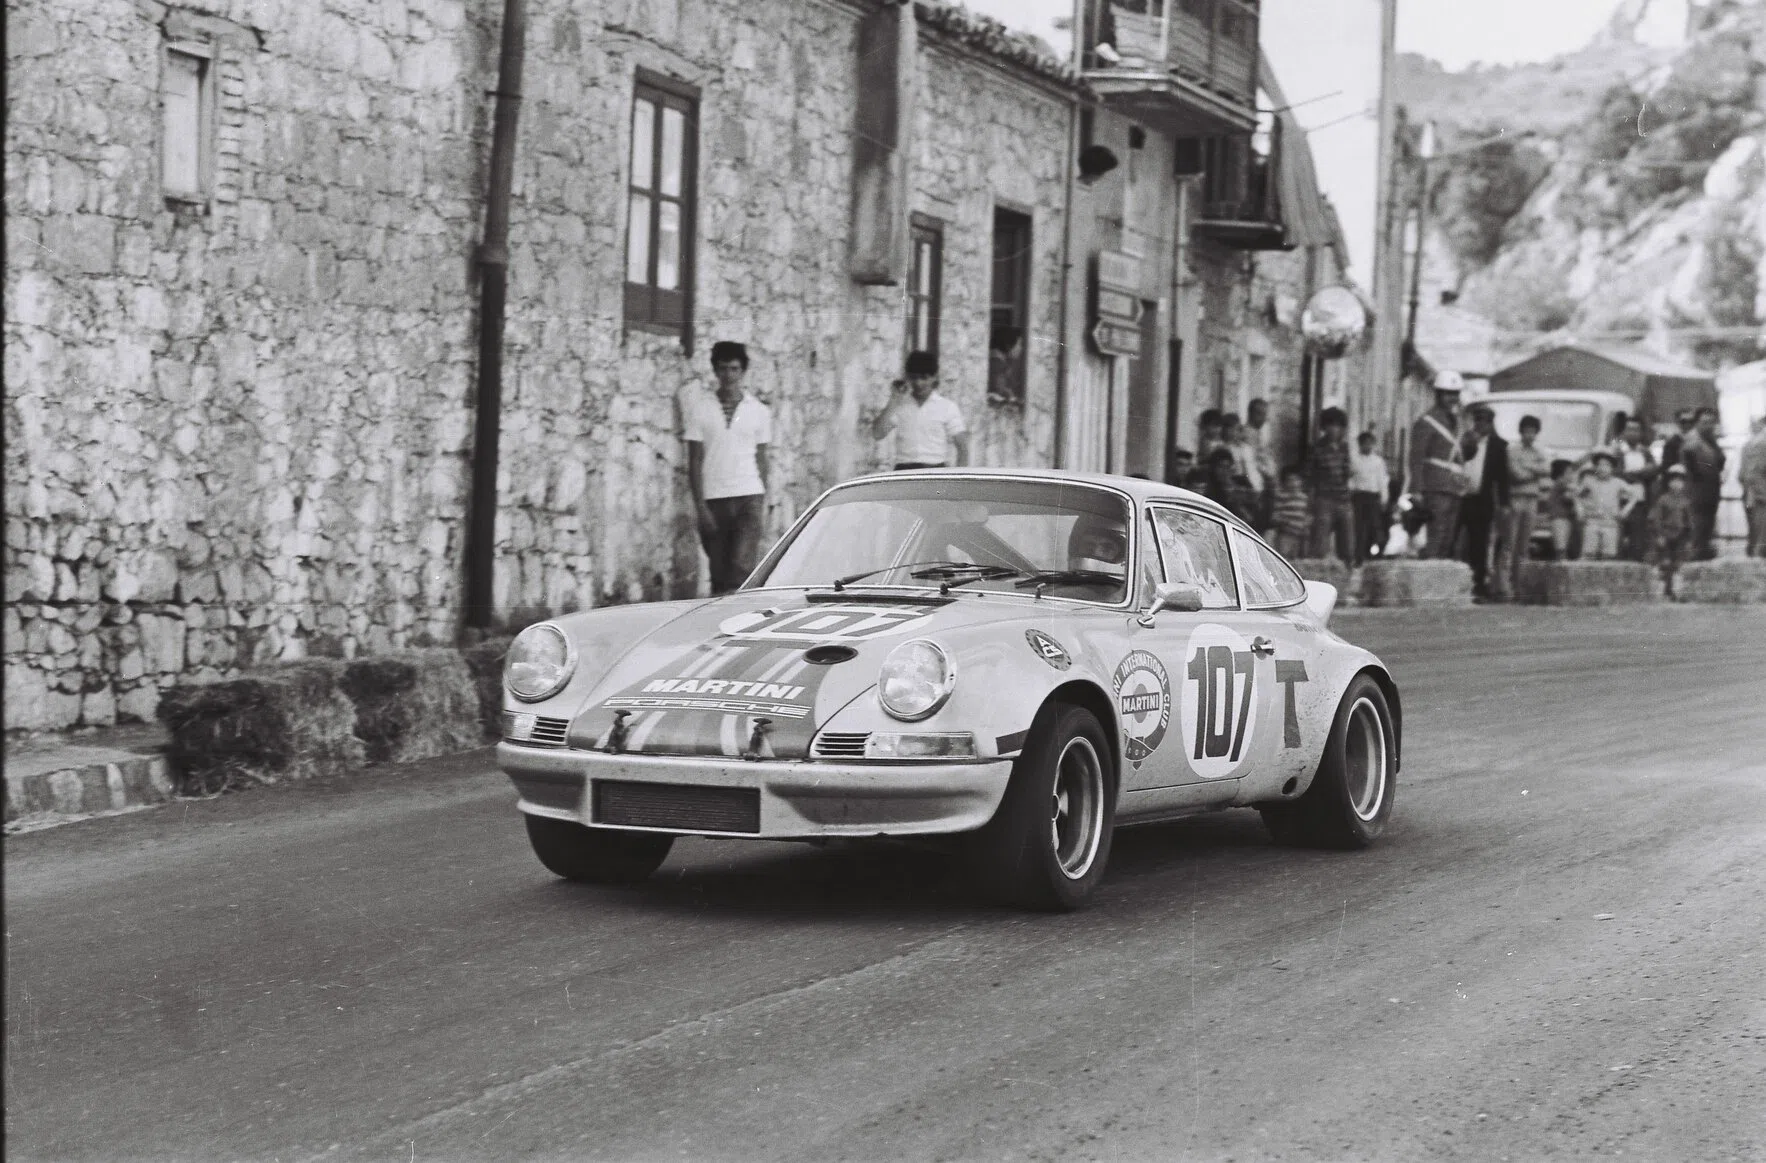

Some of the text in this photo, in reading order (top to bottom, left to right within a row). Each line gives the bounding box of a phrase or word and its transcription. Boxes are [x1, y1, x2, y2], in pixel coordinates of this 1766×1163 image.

[737, 609, 924, 637] 107
[641, 679, 805, 700] MARTINI
[1120, 653, 1167, 689] INTERNATIONAL
[1160, 693, 1170, 729] CLUB
[603, 699, 811, 716] PORSCHE
[1123, 694, 1159, 713] MARTINI
[1187, 645, 1310, 762] 107 T
